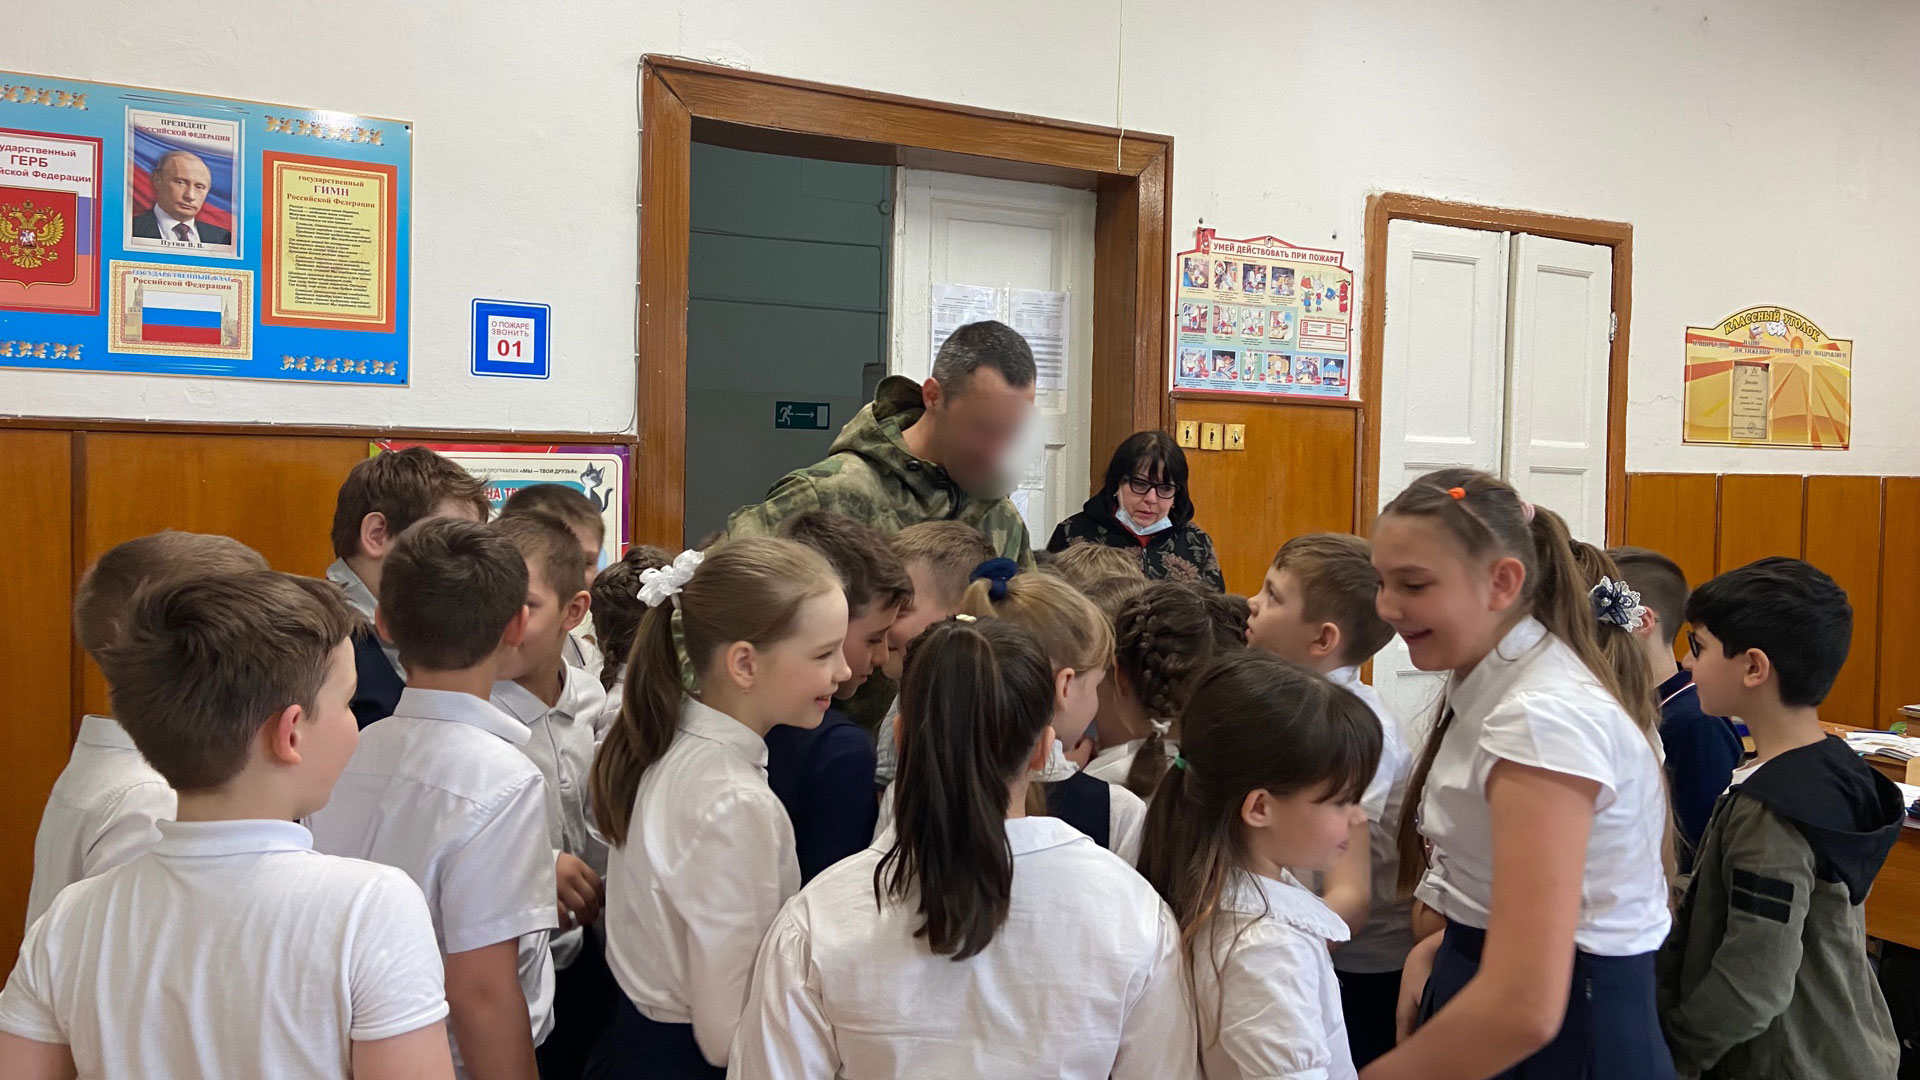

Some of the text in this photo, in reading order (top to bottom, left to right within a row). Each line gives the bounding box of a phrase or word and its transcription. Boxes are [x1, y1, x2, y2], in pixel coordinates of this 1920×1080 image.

[160, 119, 208, 130] ПРЕЗИДЕНТ
[135, 126, 231, 142] РОССИЙСКОЙ ФЕДЕРАЦИИ
[10, 154, 48, 168] ГЕРБ
[32, 170, 91, 183] Федерации
[298, 175, 364, 188] государственный
[314, 185, 349, 196] ГИМН
[286, 193, 375, 209] Российской Федерации
[160, 240, 185, 248] Путин
[1213, 241, 1339, 263] УМЕЙ ДЕЙСТВОВАТЬ ПРИ ПОЖАРЕ
[133, 276, 232, 290] Российской Федерации
[491, 320, 530, 330] О ПОЖАРЕ
[1724, 309, 1821, 342] КЛАССНЫЙ УГОЛОК
[491, 328, 530, 337] ЗВОНИТЬ
[497, 339, 521, 358] 01
